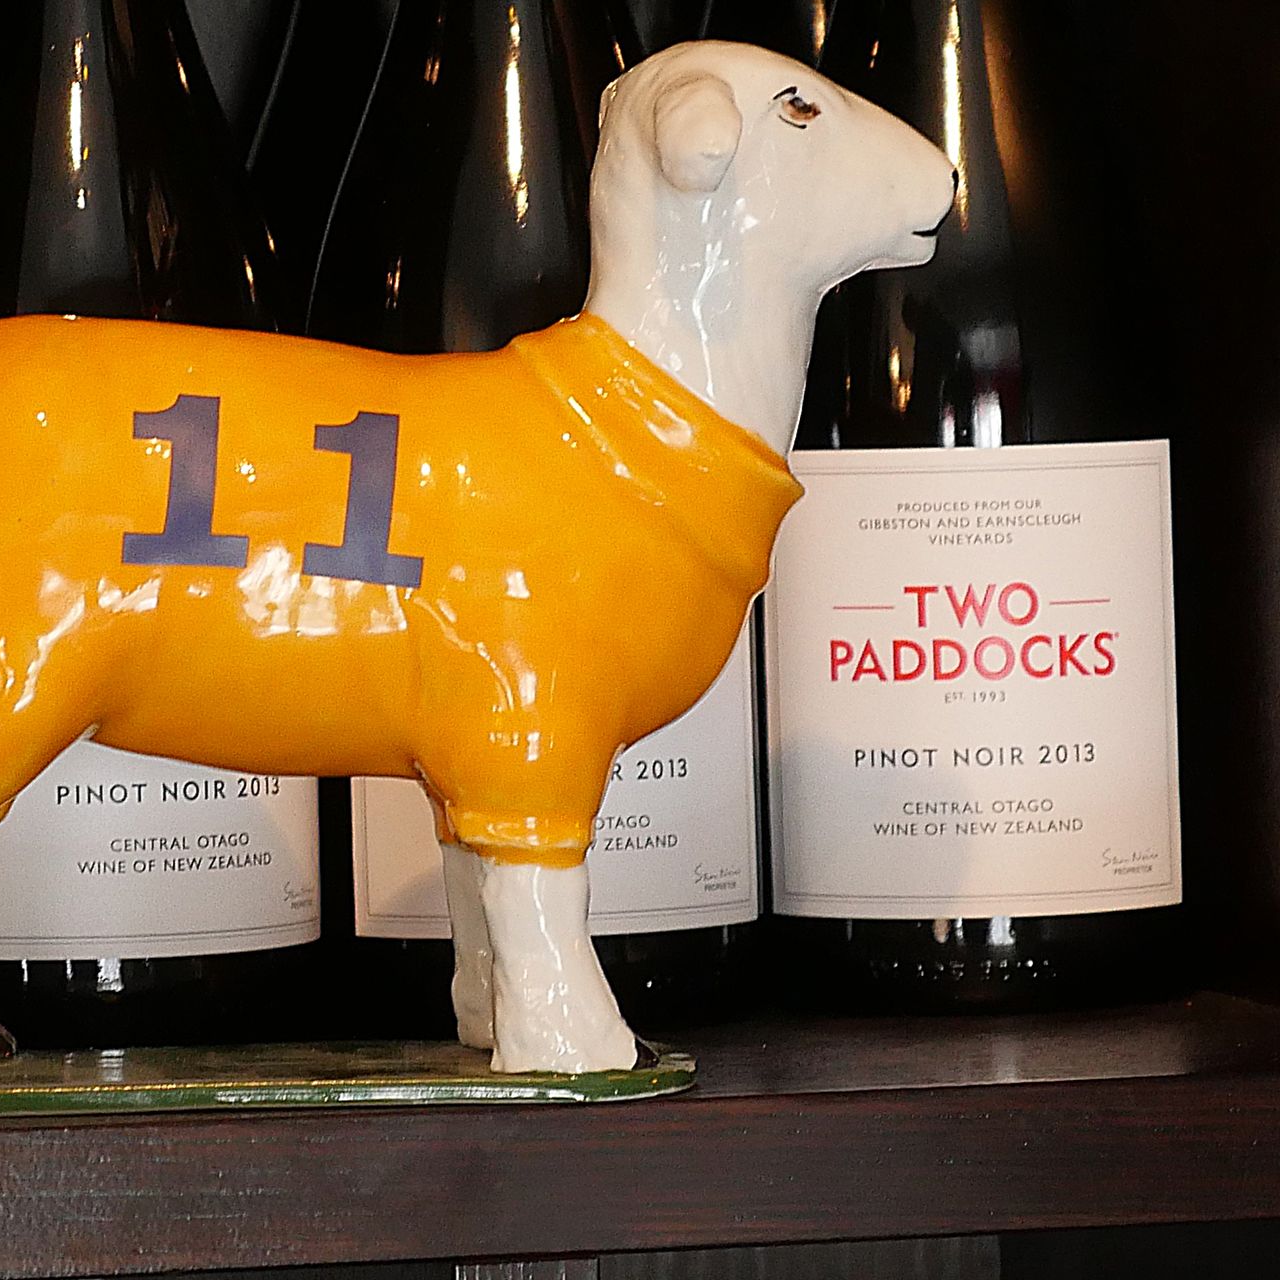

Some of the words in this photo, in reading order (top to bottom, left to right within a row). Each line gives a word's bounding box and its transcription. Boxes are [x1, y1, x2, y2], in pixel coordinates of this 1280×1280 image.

[897, 501, 969, 513] PRODUCED
[974, 500, 1010, 511] FROM
[1014, 499, 1042, 510] OUR
[859, 518, 930, 530] GIBBSTON
[937, 517, 970, 529] AND
[976, 513, 1081, 528] EARNSCLEUGH
[928, 532, 1013, 545] VINEYARDS
[903, 581, 1039, 629] TWO
[830, 631, 1116, 682] PADDOCKS
[972, 691, 1006, 703] 1993
[854, 748, 937, 768] PINOT
[953, 746, 1024, 767] NOIR
[1039, 743, 1096, 764] 2013
[636, 758, 688, 780] 2013
[56, 783, 147, 805] PINOT
[162, 780, 226, 802] NOIR
[237, 777, 281, 798] 2013
[903, 800, 983, 815] CENTRAL
[992, 798, 1054, 813] OTAGO
[594, 814, 651, 831] OTAGO
[873, 822, 918, 836] WINE
[925, 822, 947, 836] OF
[955, 821, 997, 835] NEW
[1004, 818, 1084, 834] ZEALAND
[110, 836, 189, 853] CENTRAL
[197, 832, 249, 849] OTAGO
[605, 834, 678, 851] ZEALAND
[78, 860, 126, 875] WINE
[133, 859, 156, 874] OF
[163, 857, 203, 872] NEW
[208, 852, 272, 870] ZEALAND
